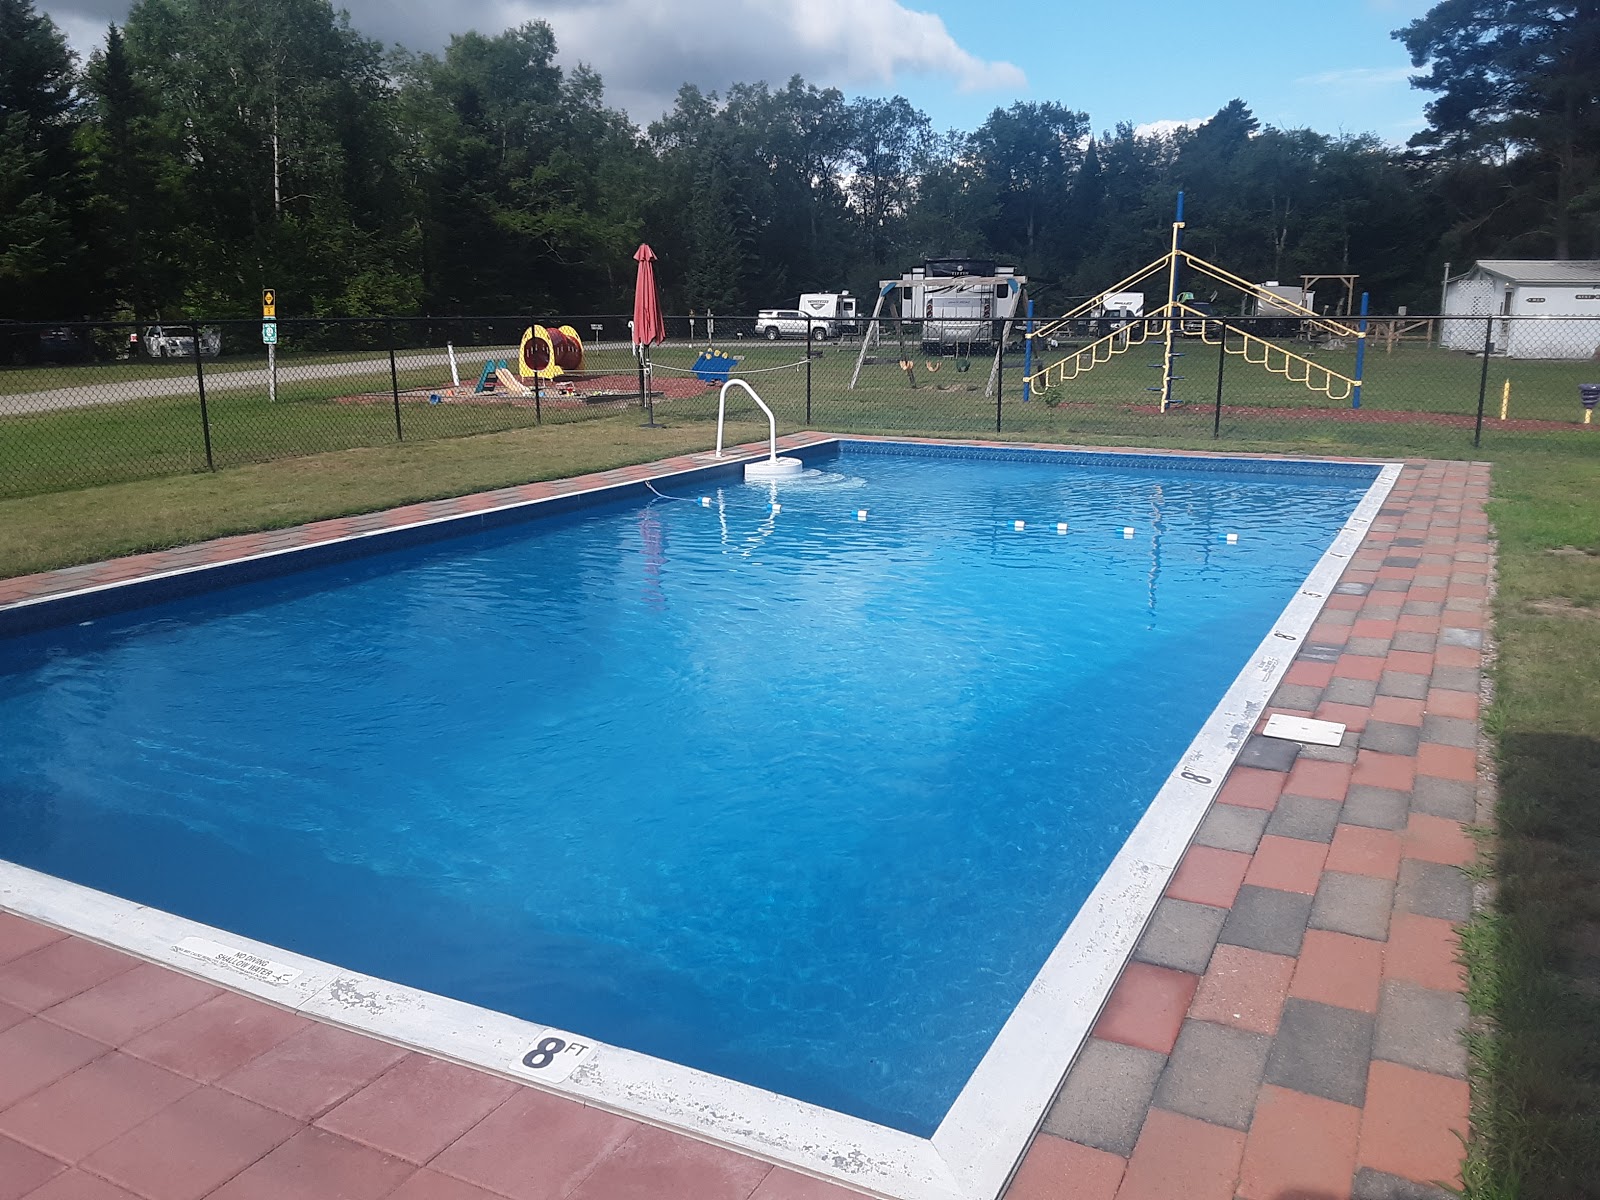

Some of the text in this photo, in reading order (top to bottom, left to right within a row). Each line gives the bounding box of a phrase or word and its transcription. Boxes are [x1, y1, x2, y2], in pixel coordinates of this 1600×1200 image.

[1181, 772, 1212, 784] 8
[215, 953, 249, 970] SHALLOW
[248, 964, 273, 977] WATER
[234, 951, 270, 967] NO DIVING
[522, 1037, 589, 1069] 8 FT
